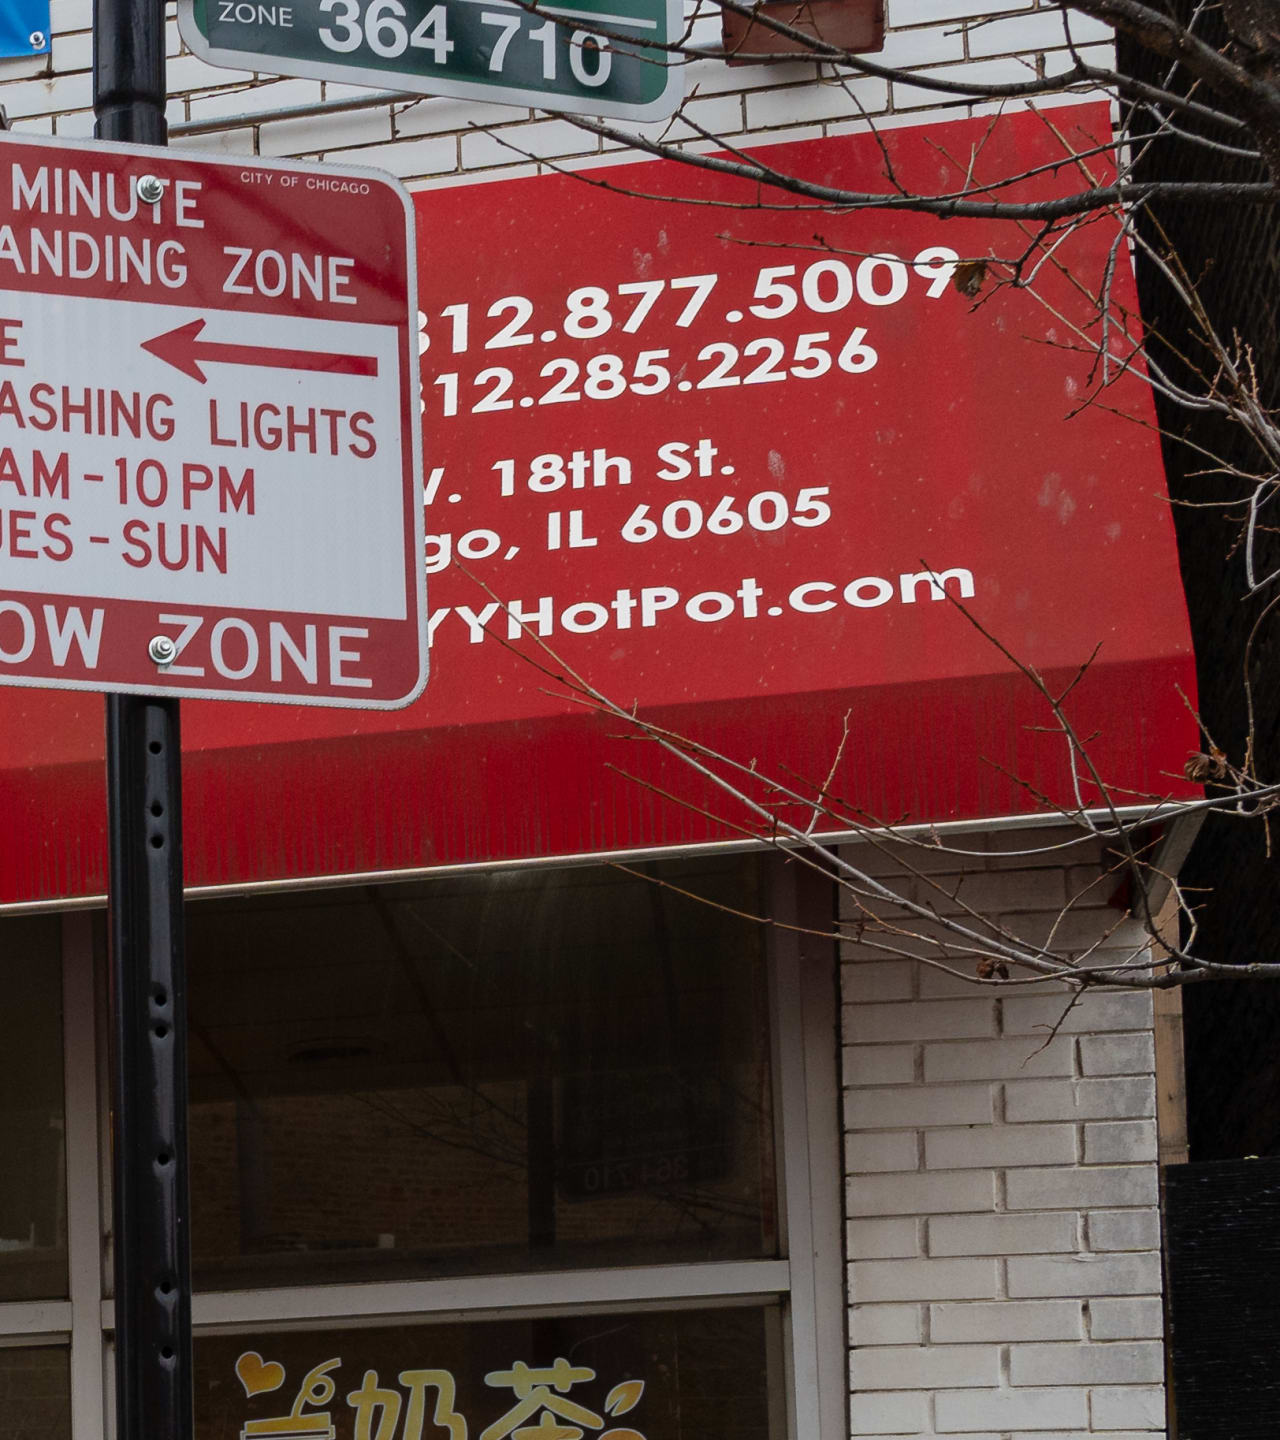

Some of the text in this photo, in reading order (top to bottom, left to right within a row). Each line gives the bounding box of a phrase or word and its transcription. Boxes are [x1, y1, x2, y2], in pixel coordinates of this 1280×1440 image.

[218, 0, 612, 87] ZONE 364 710
[13, 163, 206, 229] MINUTE
[240, 171, 371, 196] CITY OF CHICAGO
[223, 246, 358, 305] ZONE
[419, 327, 878, 418] 12.285.2256
[210, 396, 377, 460] LIGHTS
[492, 447, 632, 497] 18th
[656, 438, 735, 481] St.
[548, 510, 597, 551] IL
[621, 486, 831, 544] 60605
[158, 613, 373, 689] ZONE
